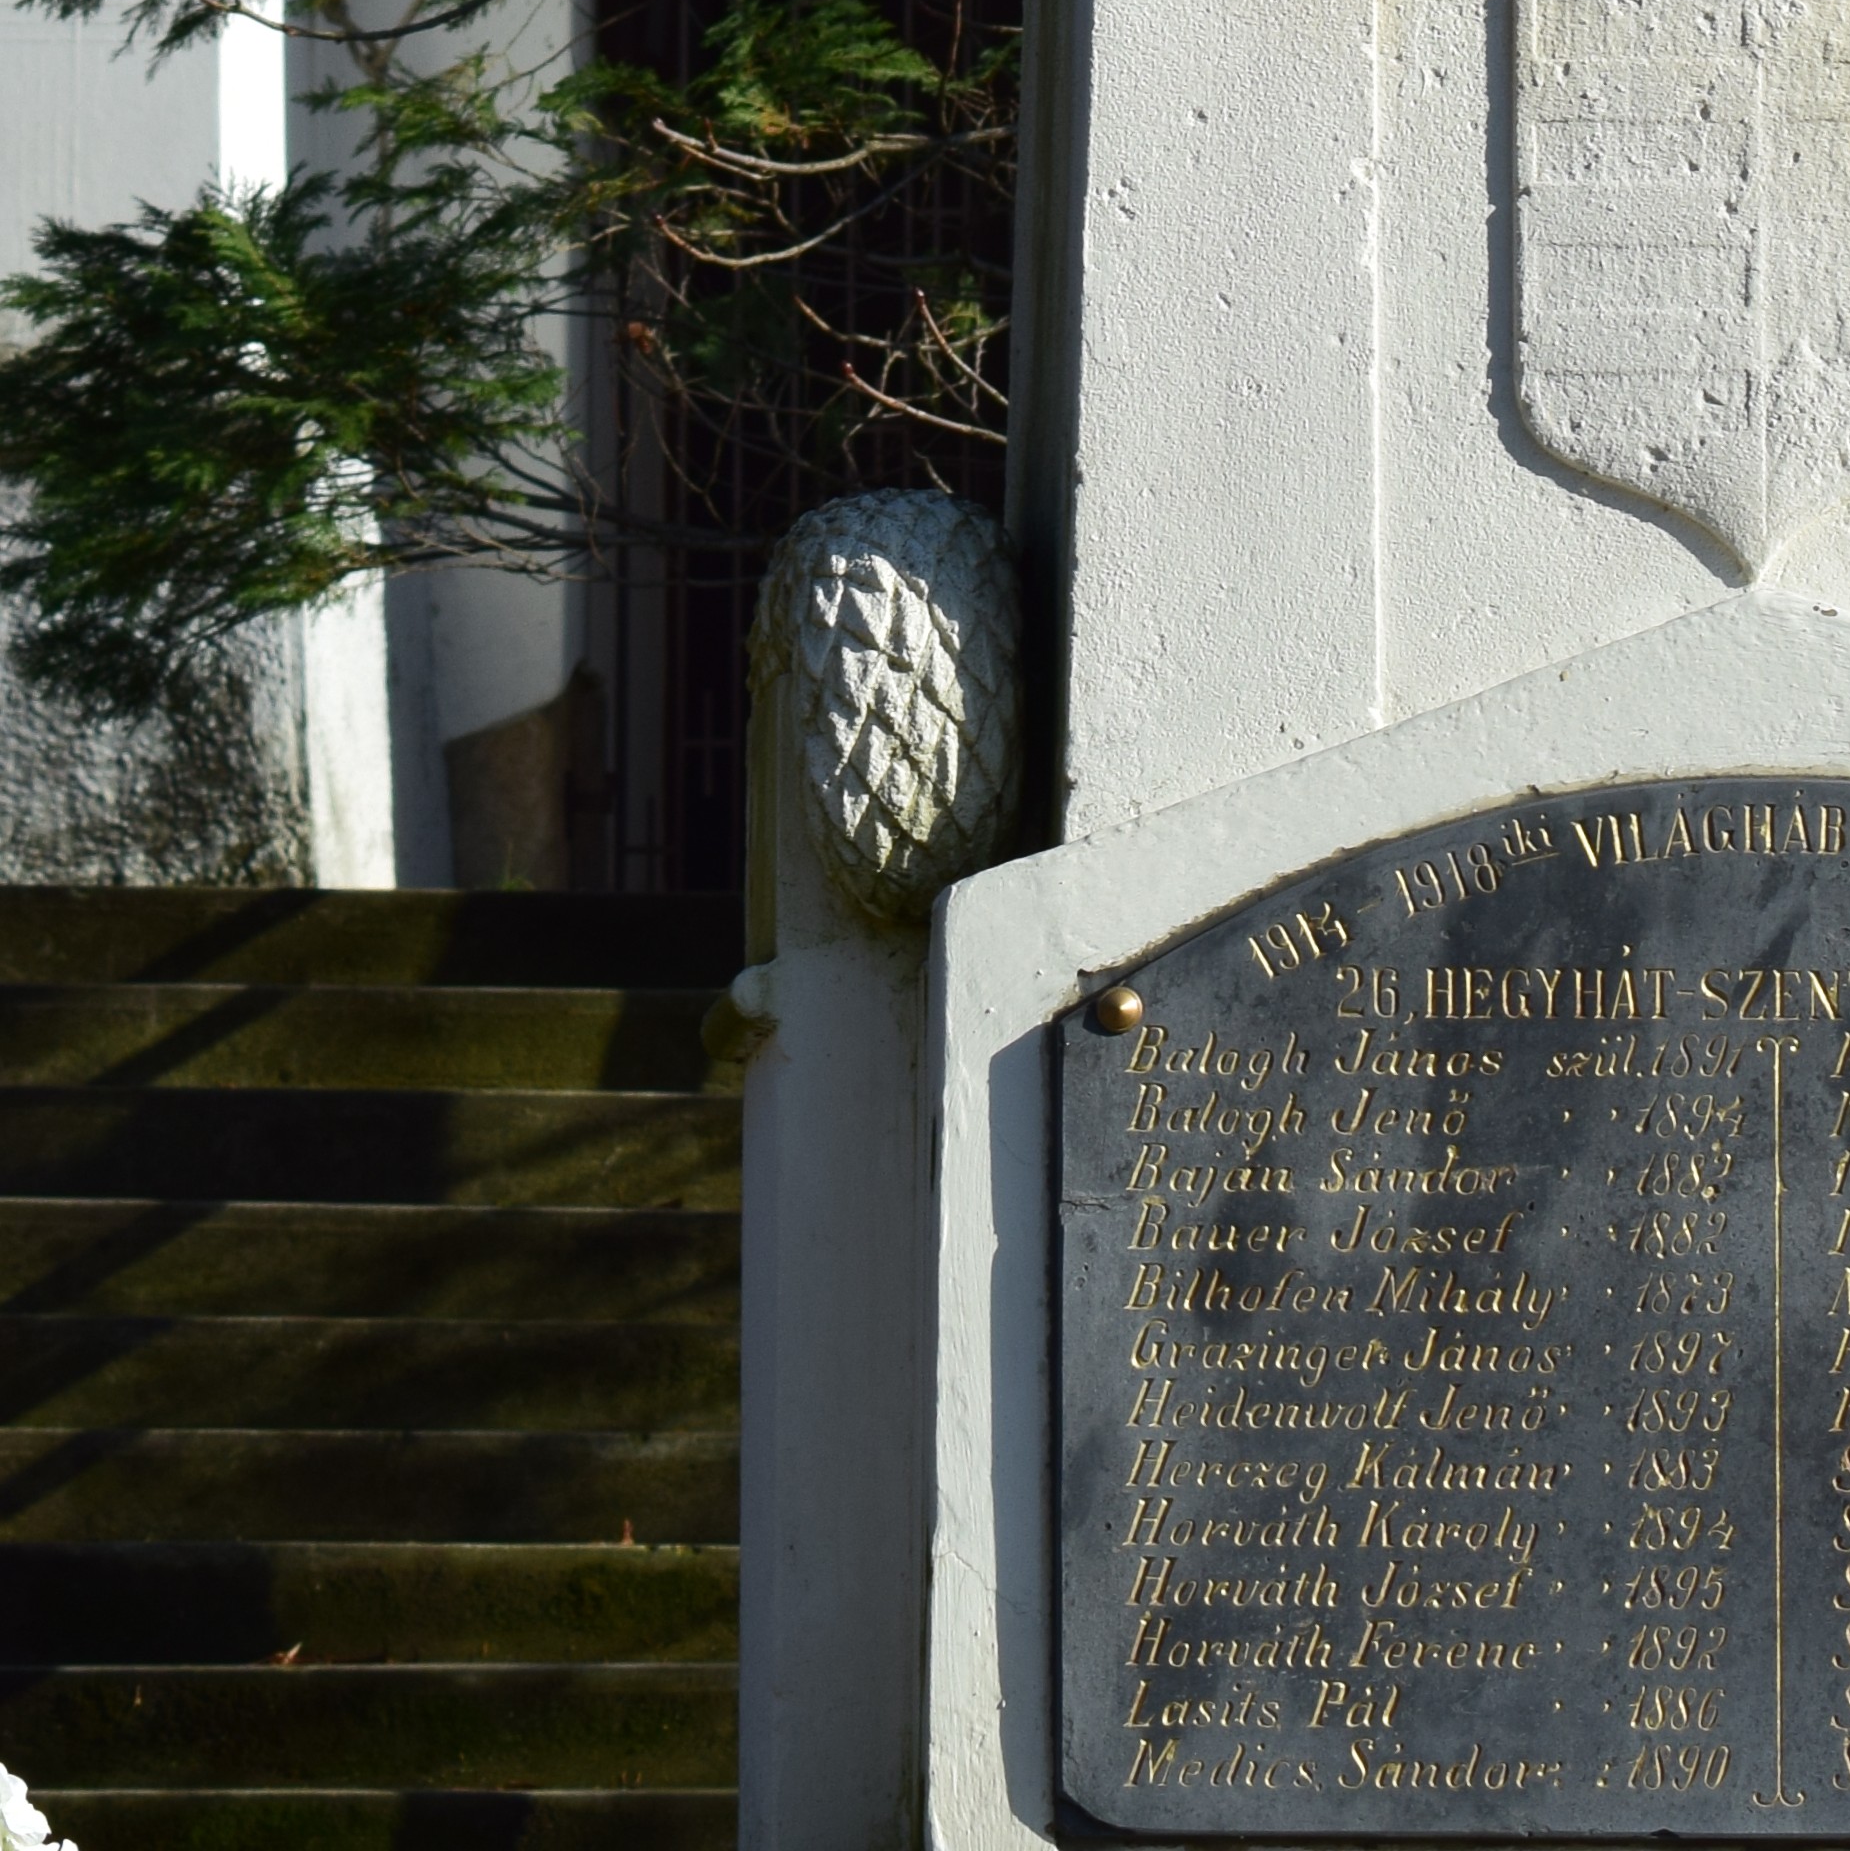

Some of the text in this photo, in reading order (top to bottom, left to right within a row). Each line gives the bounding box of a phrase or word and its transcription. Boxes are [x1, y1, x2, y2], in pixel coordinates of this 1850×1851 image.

[1248, 901, 1354, 979] 1914
[1124, 1024, 1311, 1092] Balogh
[1334, 1027, 1504, 1078] János
[1126, 1081, 1308, 1153] Balogh
[1633, 1092, 1746, 1140] 1894
[1320, 1145, 1518, 1196] Sándor
[1128, 1197, 1728, 1259] Bauer József 1882
[1124, 1262, 1353, 1314] Bilhofen
[1365, 1264, 1555, 1331] Mihály
[1129, 1319, 1734, 1388] Grazinger János 1897
[1125, 1377, 1418, 1431] Heidenwolf
[1626, 1387, 1734, 1433] 1893
[1125, 1439, 1330, 1505] Herczeg
[1345, 1440, 1559, 1492] Kálmán
[1122, 1496, 1736, 1565] Horváth Károly 1894
[1125, 1555, 1727, 1611] Horváth József 1895
[1124, 1615, 1728, 1671] Horváth Ferenc 1892
[1308, 1679, 1403, 1730] Pál
[1629, 1685, 1725, 1731] 1886
[1337, 1738, 1562, 1791] Sándor
[1628, 1743, 1731, 1791] 1890
